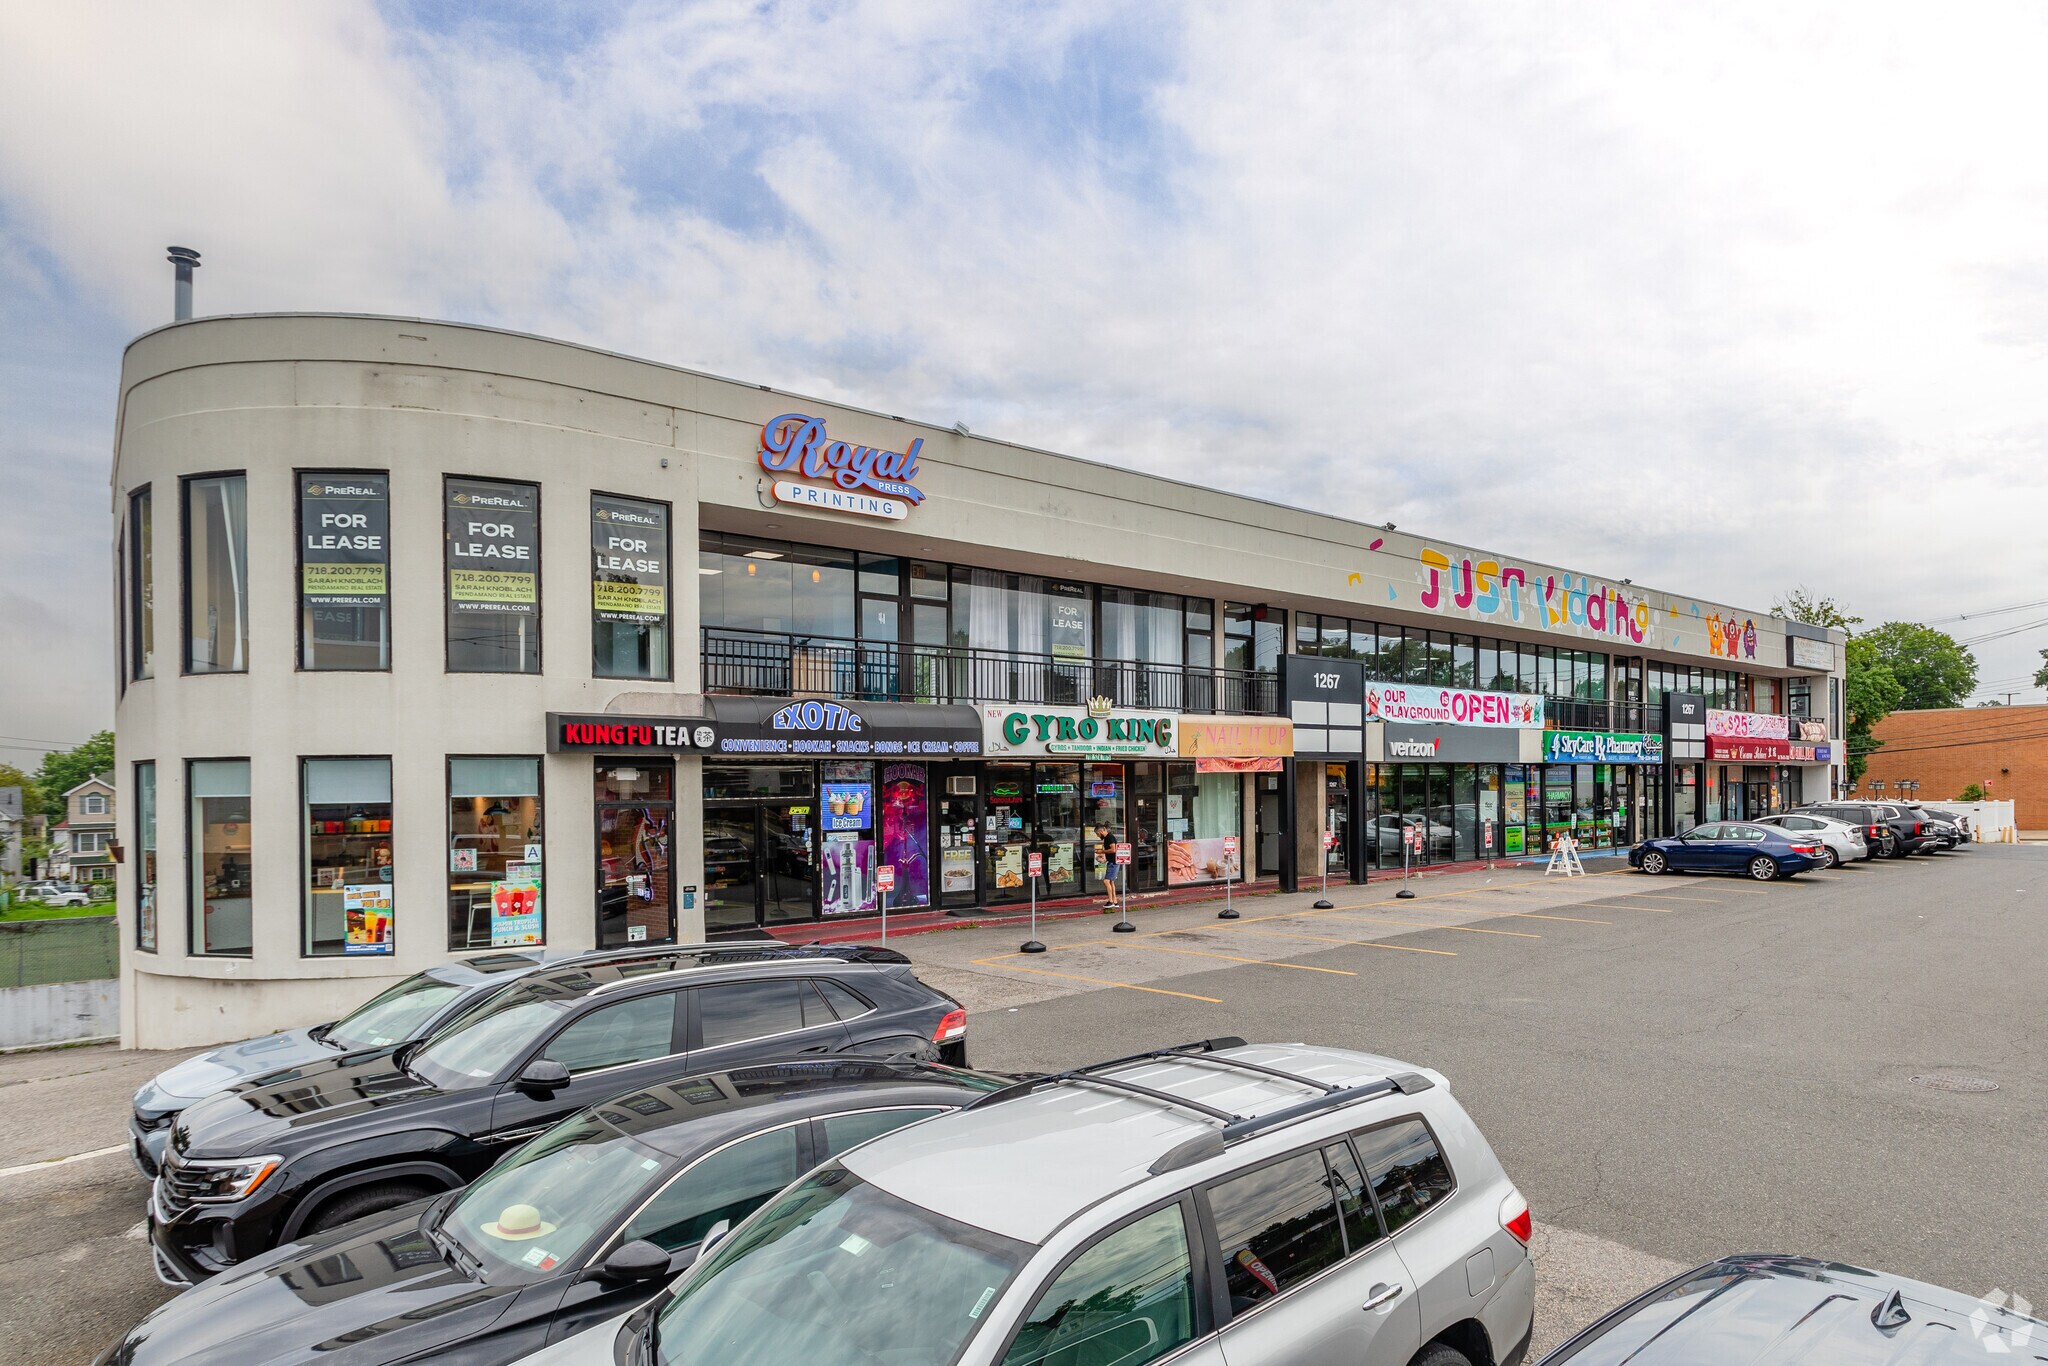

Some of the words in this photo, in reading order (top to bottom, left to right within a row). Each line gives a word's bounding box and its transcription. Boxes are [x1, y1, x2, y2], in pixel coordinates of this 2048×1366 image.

[758, 413, 924, 490] Royal
[878, 482, 910, 495] PRESS
[793, 487, 893, 514] PRINTING
[321, 513, 368, 528] FOR
[468, 522, 515, 538] FOR
[307, 535, 382, 550] LEASE
[608, 536, 647, 554] FOR
[454, 542, 530, 560] LEASE
[307, 566, 383, 576] 718.200.7799
[597, 555, 660, 574] LEASE
[454, 573, 532, 584] 718.200.7799
[1420, 547, 1526, 623] JUST
[455, 584, 485, 592] SARAH
[486, 585, 533, 593] KNOBLACH
[597, 584, 661, 597] 718.200.7799
[597, 594, 623, 602] SARAH
[458, 603, 530, 612] WWW.PREREAL.COM
[1058, 605, 1078, 616] FOR
[313, 610, 352, 623] EASE
[600, 612, 660, 622] WWW.PREREAL.COM
[1052, 618, 1084, 630] LEASE
[1313, 672, 1341, 689] 1267
[1384, 689, 1406, 704] OUR
[987, 710, 1003, 718] NEW
[1384, 705, 1450, 721] PLAYGROUND
[1451, 692, 1510, 724] OPEN
[1681, 703, 1695, 715] 1267
[773, 702, 862, 732] EXOTIC
[565, 723, 625, 745] KUNG
[627, 724, 652, 745] FU
[654, 725, 691, 746] TEA
[1003, 712, 1099, 746] GYRO
[1107, 718, 1172, 748] KING
[1205, 725, 1242, 746] NAIL
[1249, 726, 1262, 745] IT
[1267, 727, 1287, 746] UP
[721, 738, 788, 753] CONVENIENCE
[792, 739, 831, 753] HOOKAH
[836, 740, 870, 753] SNACKS
[874, 741, 903, 753] BONGS
[907, 741, 920, 753] ICE
[921, 741, 949, 753] CREAM
[953, 741, 979, 753] COFFEE
[1389, 738, 1435, 757] verizon
[1561, 735, 1594, 757] SkyCare
[1606, 736, 1642, 757] Pharmacy
[883, 763, 926, 784] HOOKAH
[832, 817, 843, 829] Ice
[843, 816, 863, 828] Cream
[987, 818, 995, 827] A
[527, 846, 539, 858] A
[943, 849, 972, 861] FREE
